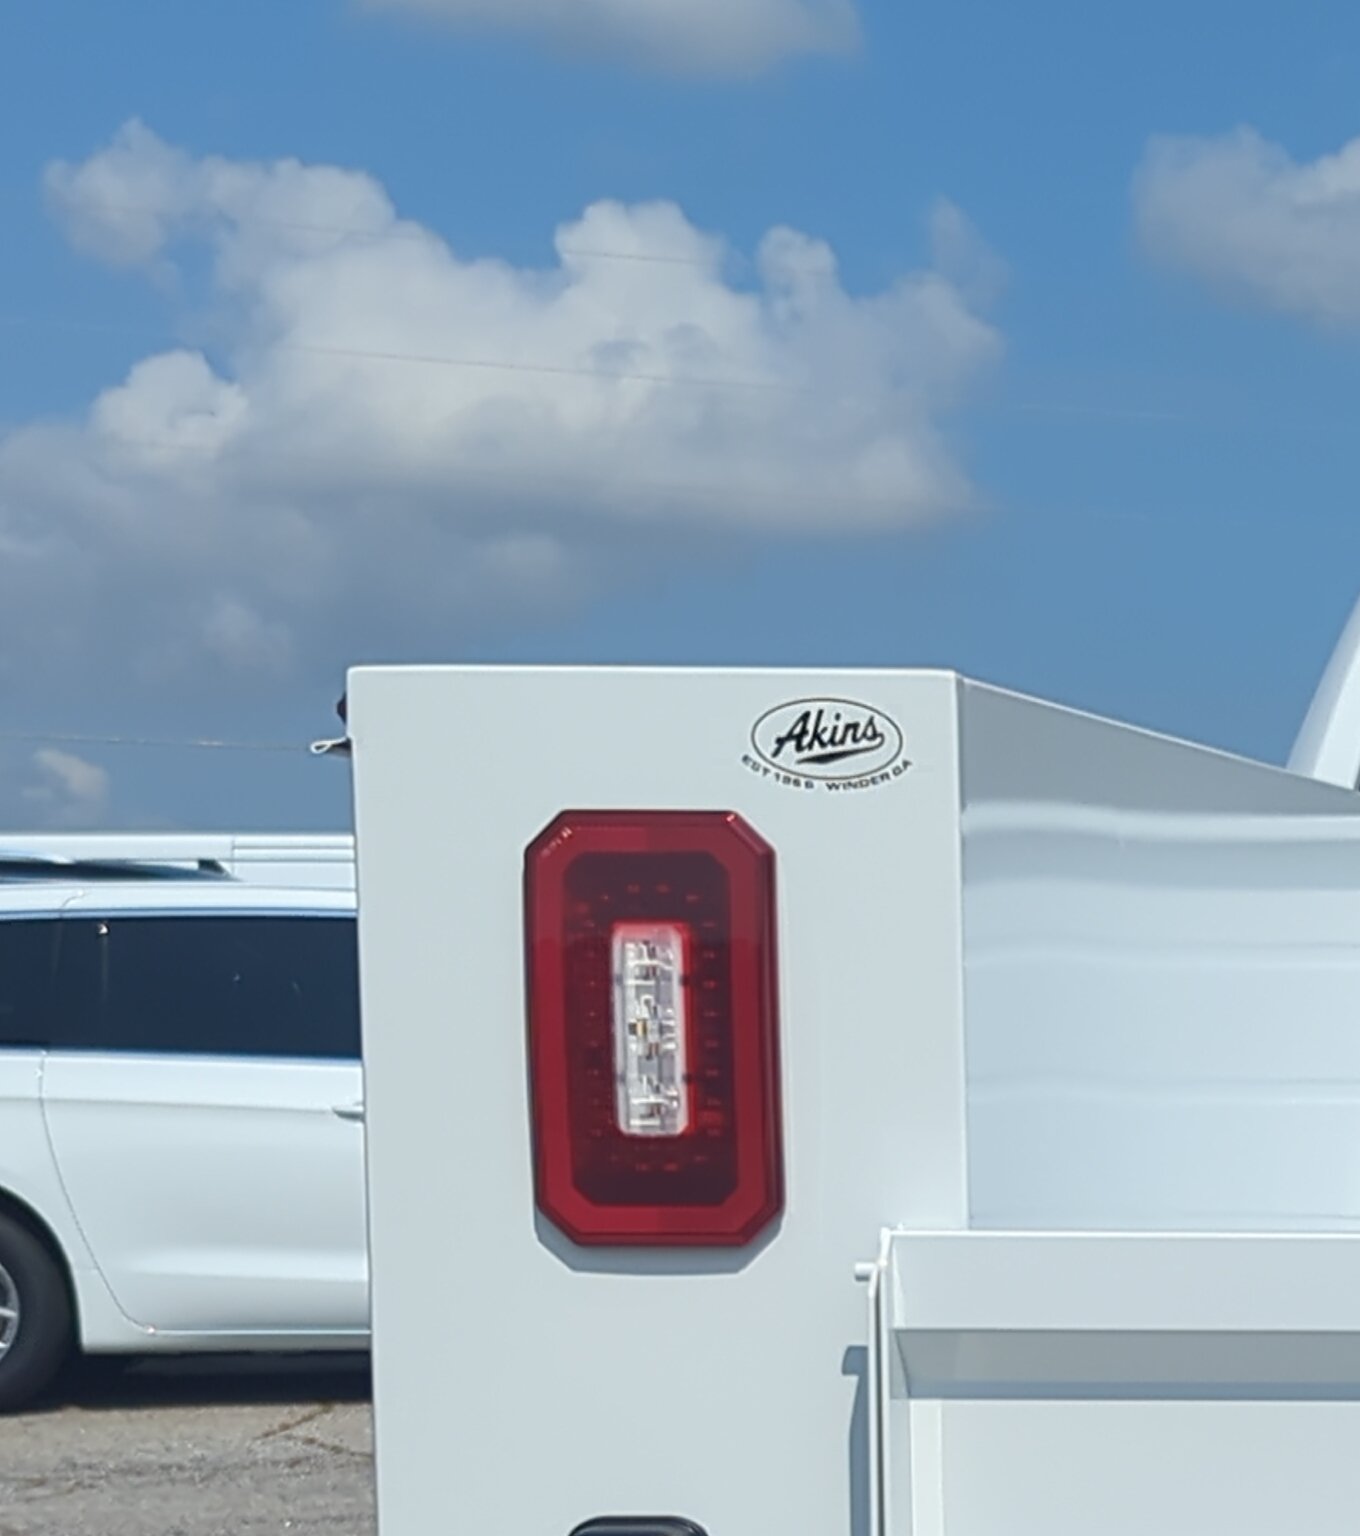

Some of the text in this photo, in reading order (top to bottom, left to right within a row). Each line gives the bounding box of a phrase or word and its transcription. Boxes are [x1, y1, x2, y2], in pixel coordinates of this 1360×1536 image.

[771, 709, 885, 758] Akins
[742, 754, 771, 777] EST
[825, 771, 891, 791] WINDER
[892, 760, 912, 777] GA
